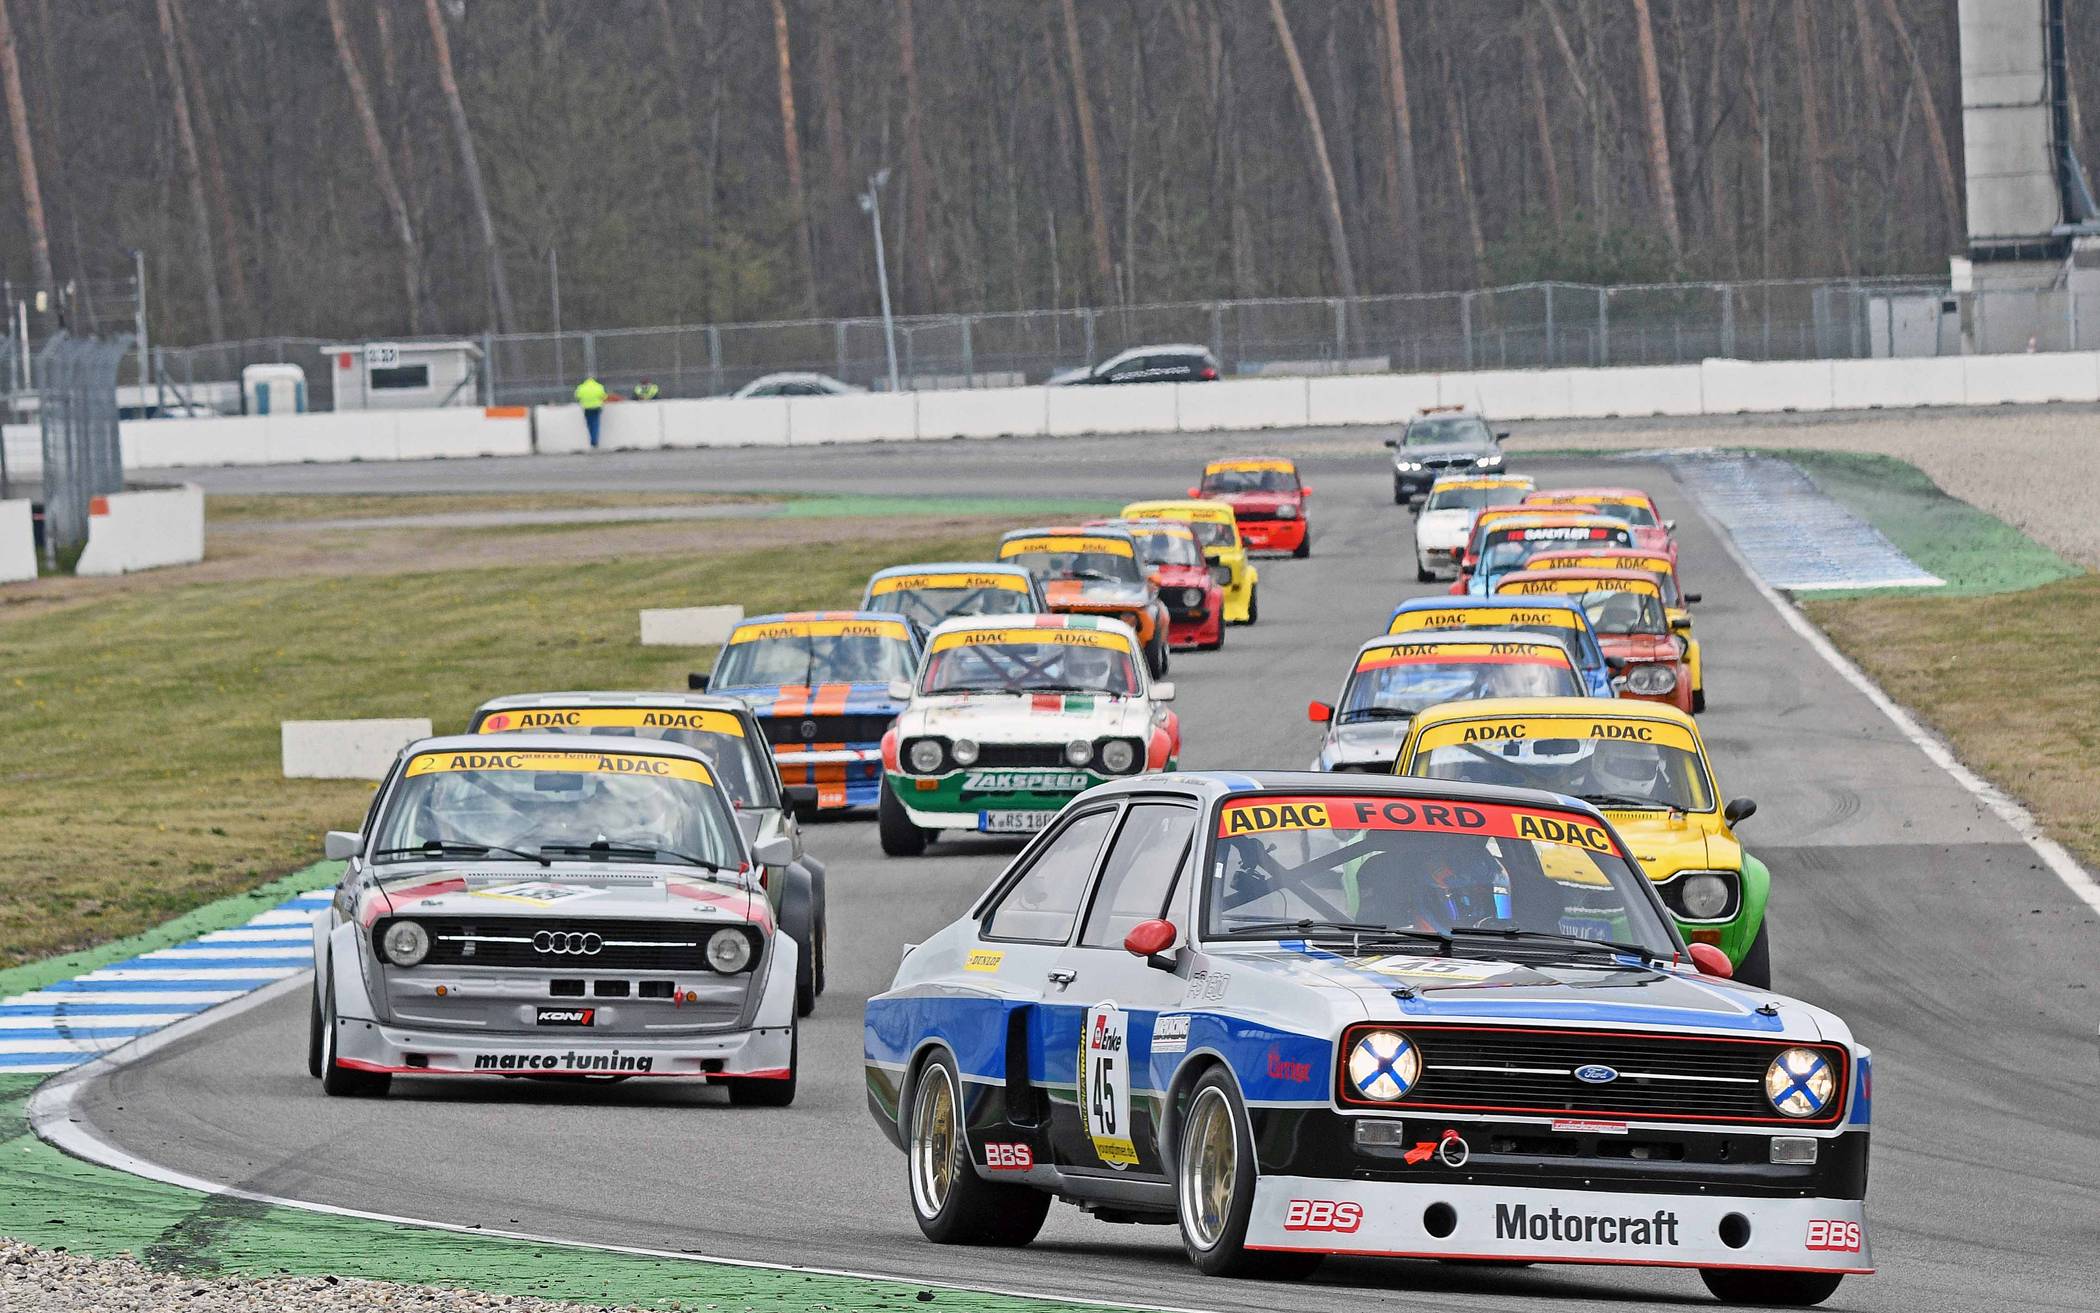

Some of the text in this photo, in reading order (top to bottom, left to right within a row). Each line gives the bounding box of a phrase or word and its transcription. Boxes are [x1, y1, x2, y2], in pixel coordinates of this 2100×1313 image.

[1615, 558, 1649, 569] ADAC
[1521, 580, 1632, 595] ADAC ADAC
[1424, 613, 1552, 626] ADAC ADAC
[758, 625, 880, 638] ADAC ADAC
[963, 633, 1099, 646] ADAC ADAC
[1390, 644, 1539, 658] ADAC ADAC
[520, 712, 580, 727] ADAC
[642, 713, 704, 728] ADAC
[1463, 724, 1653, 742] ADAC ADAC
[421, 755, 523, 771] 2 ADAC
[597, 757, 670, 775] ADAC
[961, 772, 1089, 791] ZAKSPEED
[988, 812, 996, 828] K
[1229, 802, 1610, 851] ADAC FORD ADAC
[1387, 961, 1461, 973] 45
[1101, 1026, 1122, 1052] Enke
[474, 1050, 653, 1072] marco tuning
[1584, 1067, 1609, 1079] Ford
[1093, 1056, 1116, 1135] 45
[984, 1143, 1031, 1167] BBS
[1284, 1200, 1361, 1232] BBS
[1495, 1202, 1679, 1246] Motorcraft
[1804, 1219, 1861, 1252] BBS
